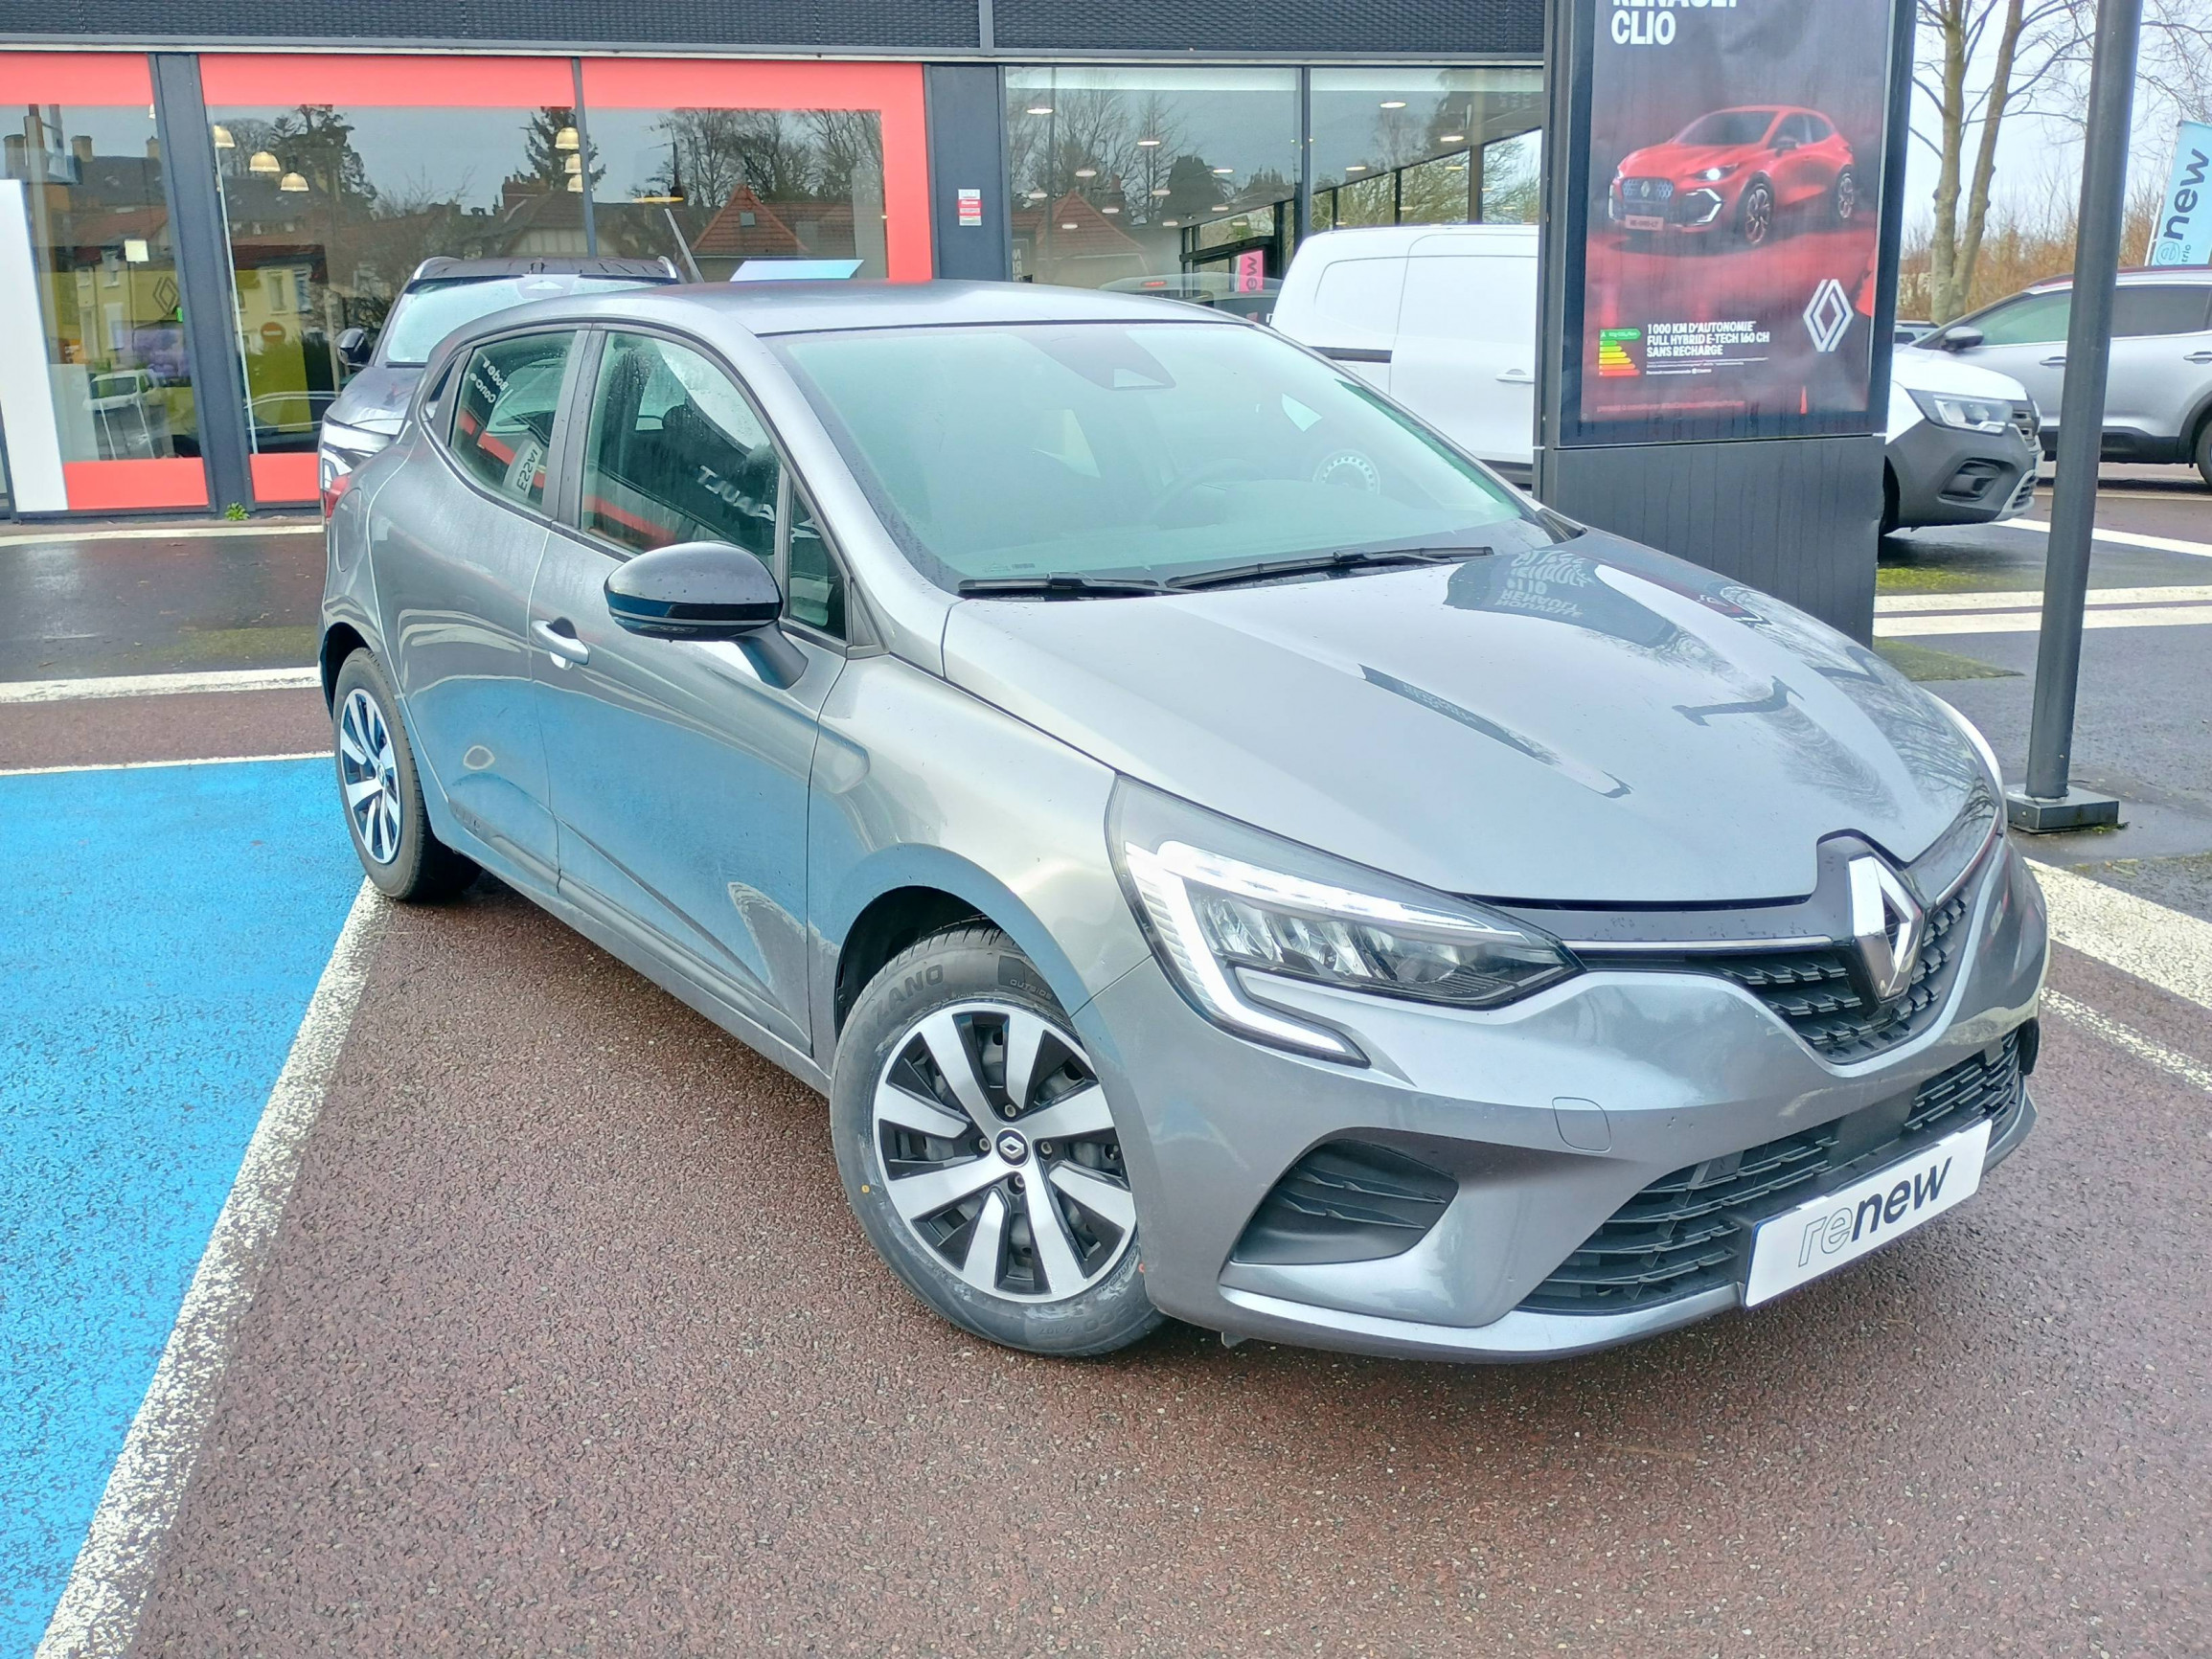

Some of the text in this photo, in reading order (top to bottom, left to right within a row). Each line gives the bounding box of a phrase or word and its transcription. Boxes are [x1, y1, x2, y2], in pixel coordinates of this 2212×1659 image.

[1611, 10, 1676, 45] CLIO
[1673, 323, 1687, 333] KM
[1647, 331, 1769, 346] FULL HYBRID E-TECH 160 CH
[1647, 345, 1723, 357] SANS RECHARGE
[1010, 978, 1054, 1000] OUTSIDE
[1797, 1156, 1952, 1268] renew
